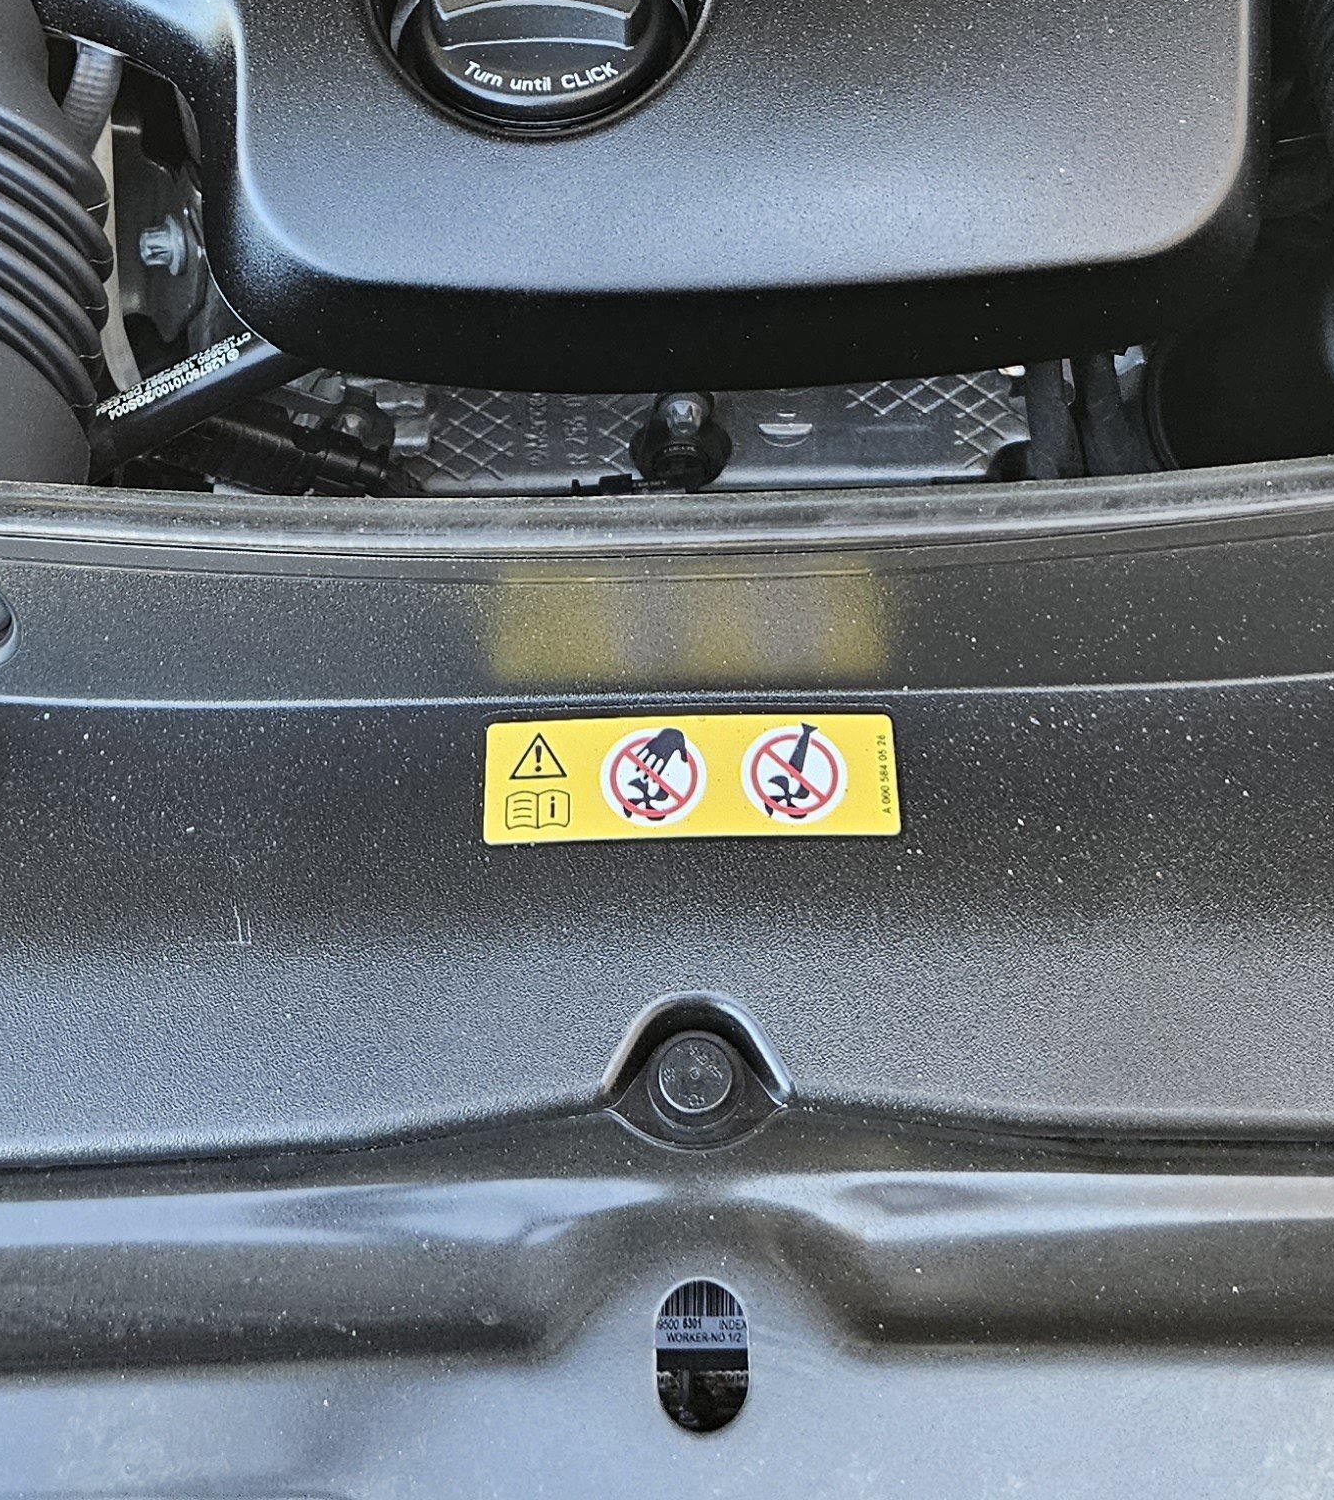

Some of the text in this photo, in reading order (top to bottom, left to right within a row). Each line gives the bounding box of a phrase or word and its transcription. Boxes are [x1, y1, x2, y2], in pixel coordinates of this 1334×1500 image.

[464, 61, 619, 92] Turn until CLICK
